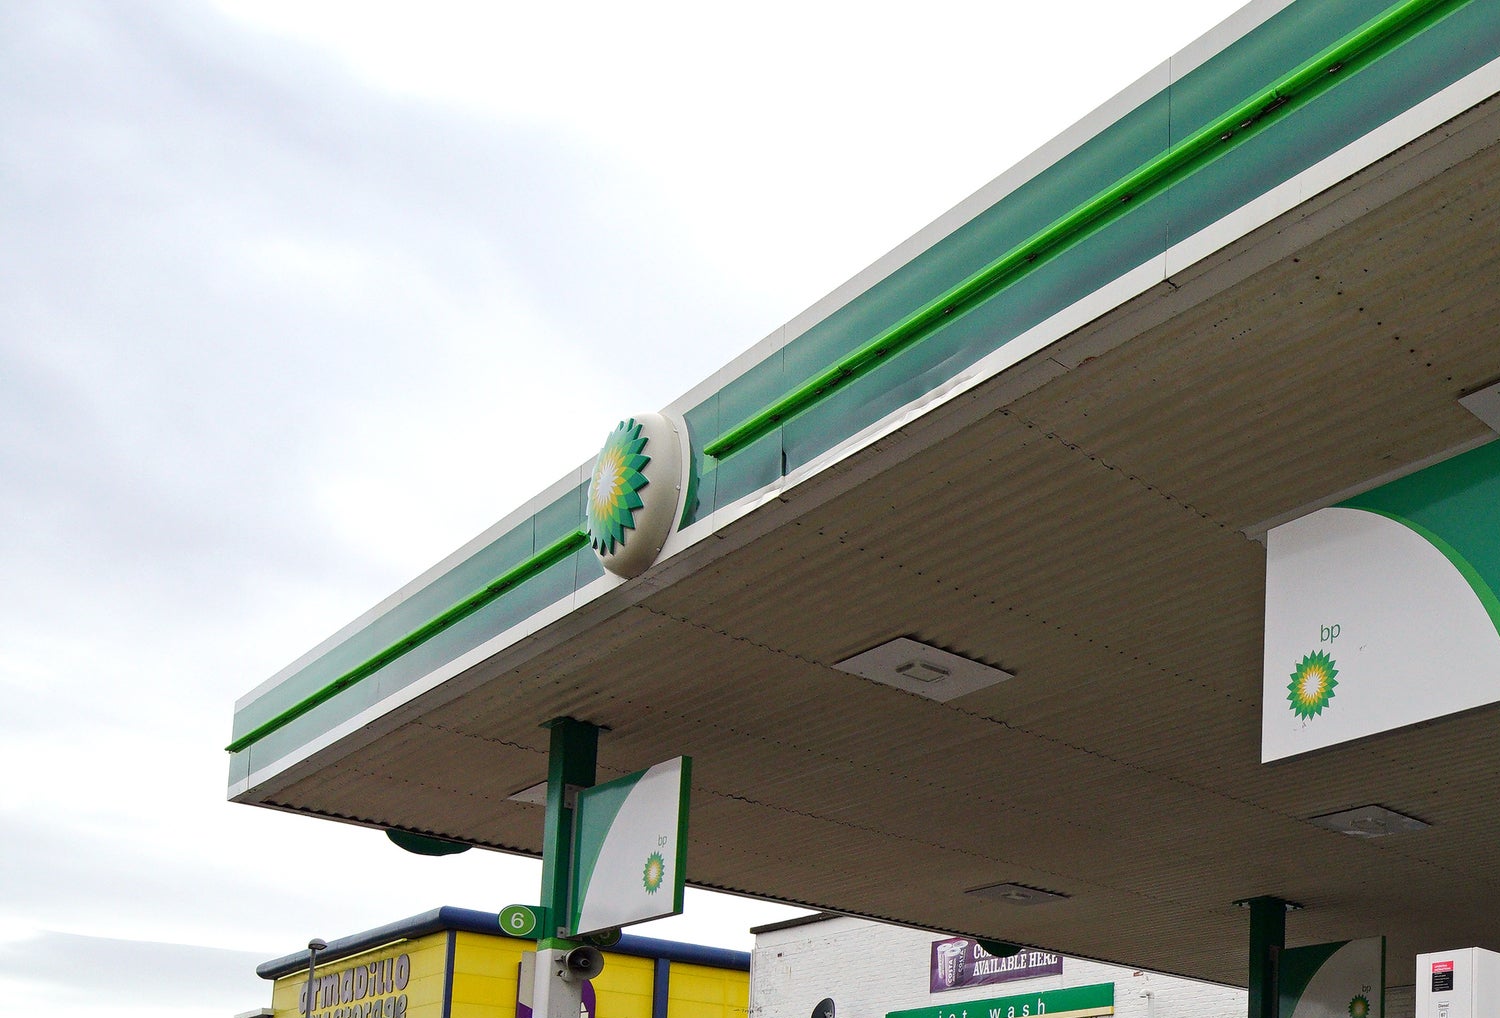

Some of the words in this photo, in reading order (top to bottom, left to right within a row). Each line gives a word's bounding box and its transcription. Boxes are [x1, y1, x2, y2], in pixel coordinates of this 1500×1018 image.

[1320, 622, 1342, 643] bp
[658, 834, 668, 848] bp
[510, 912, 524, 929] 6
[973, 953, 1027, 977] AVAILABLE
[1028, 951, 1058, 970] HERE
[1362, 984, 1372, 994] bp
